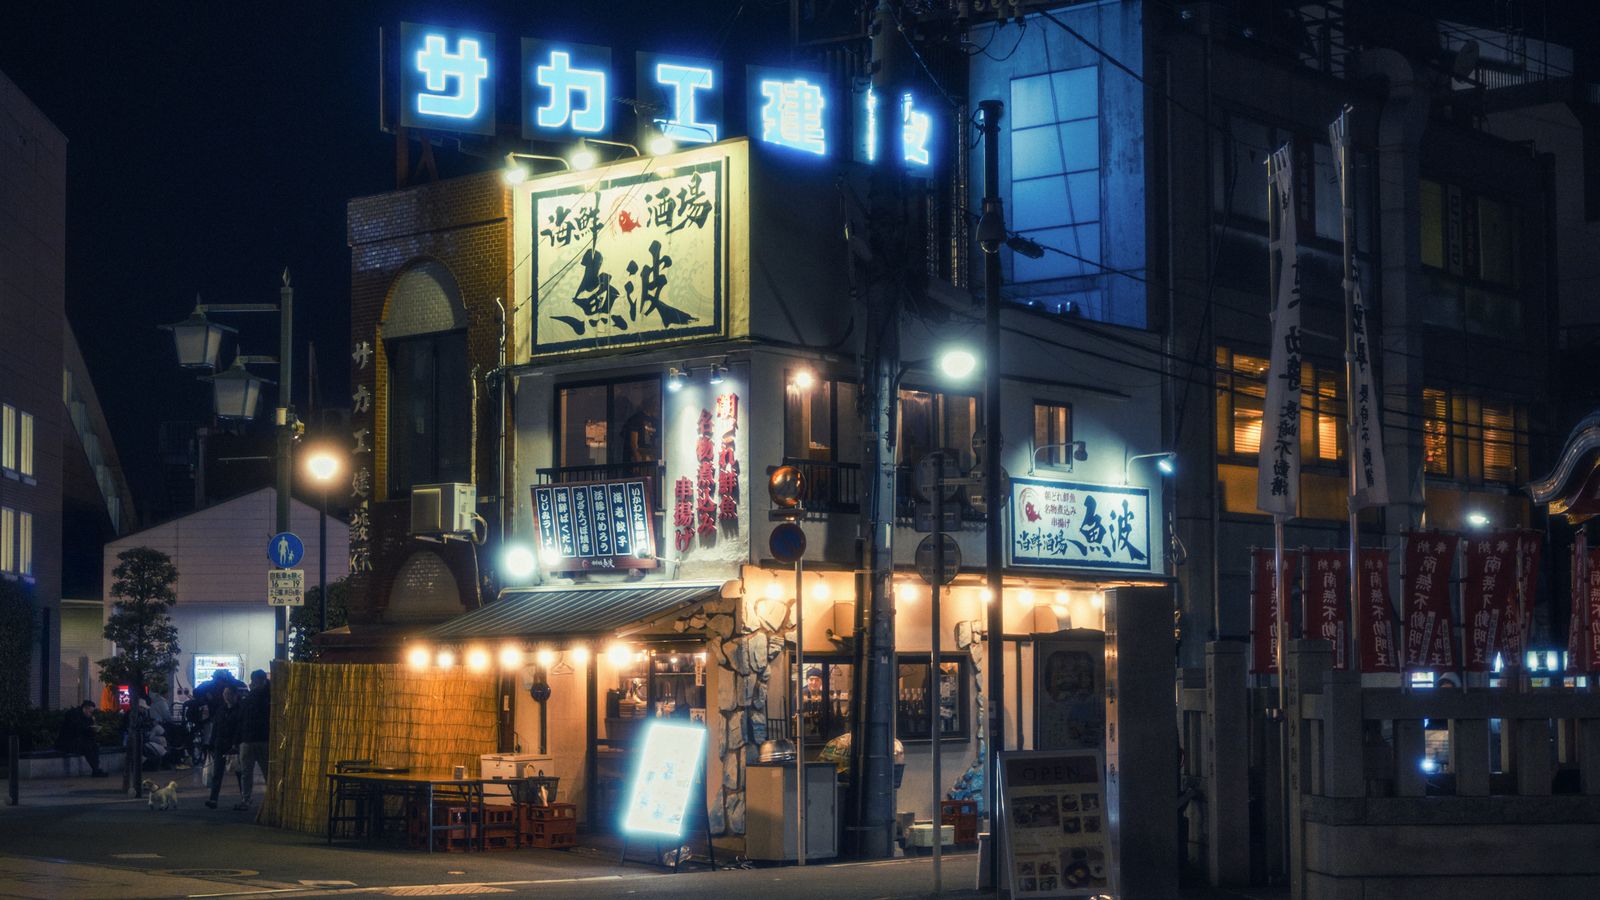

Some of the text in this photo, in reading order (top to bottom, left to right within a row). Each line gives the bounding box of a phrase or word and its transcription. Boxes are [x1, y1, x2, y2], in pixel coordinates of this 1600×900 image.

[541, 170, 714, 247] 海鮮 酒場
[549, 240, 701, 337] 魚波
[696, 408, 717, 537] 名物煮込み
[540, 494, 556, 553] しじみラーメ
[674, 476, 695, 552] 串揚げ
[1017, 528, 1068, 559] 海鮮酒場
[1066, 495, 1148, 561] 魚波
[1023, 765, 1081, 782] OPEN
